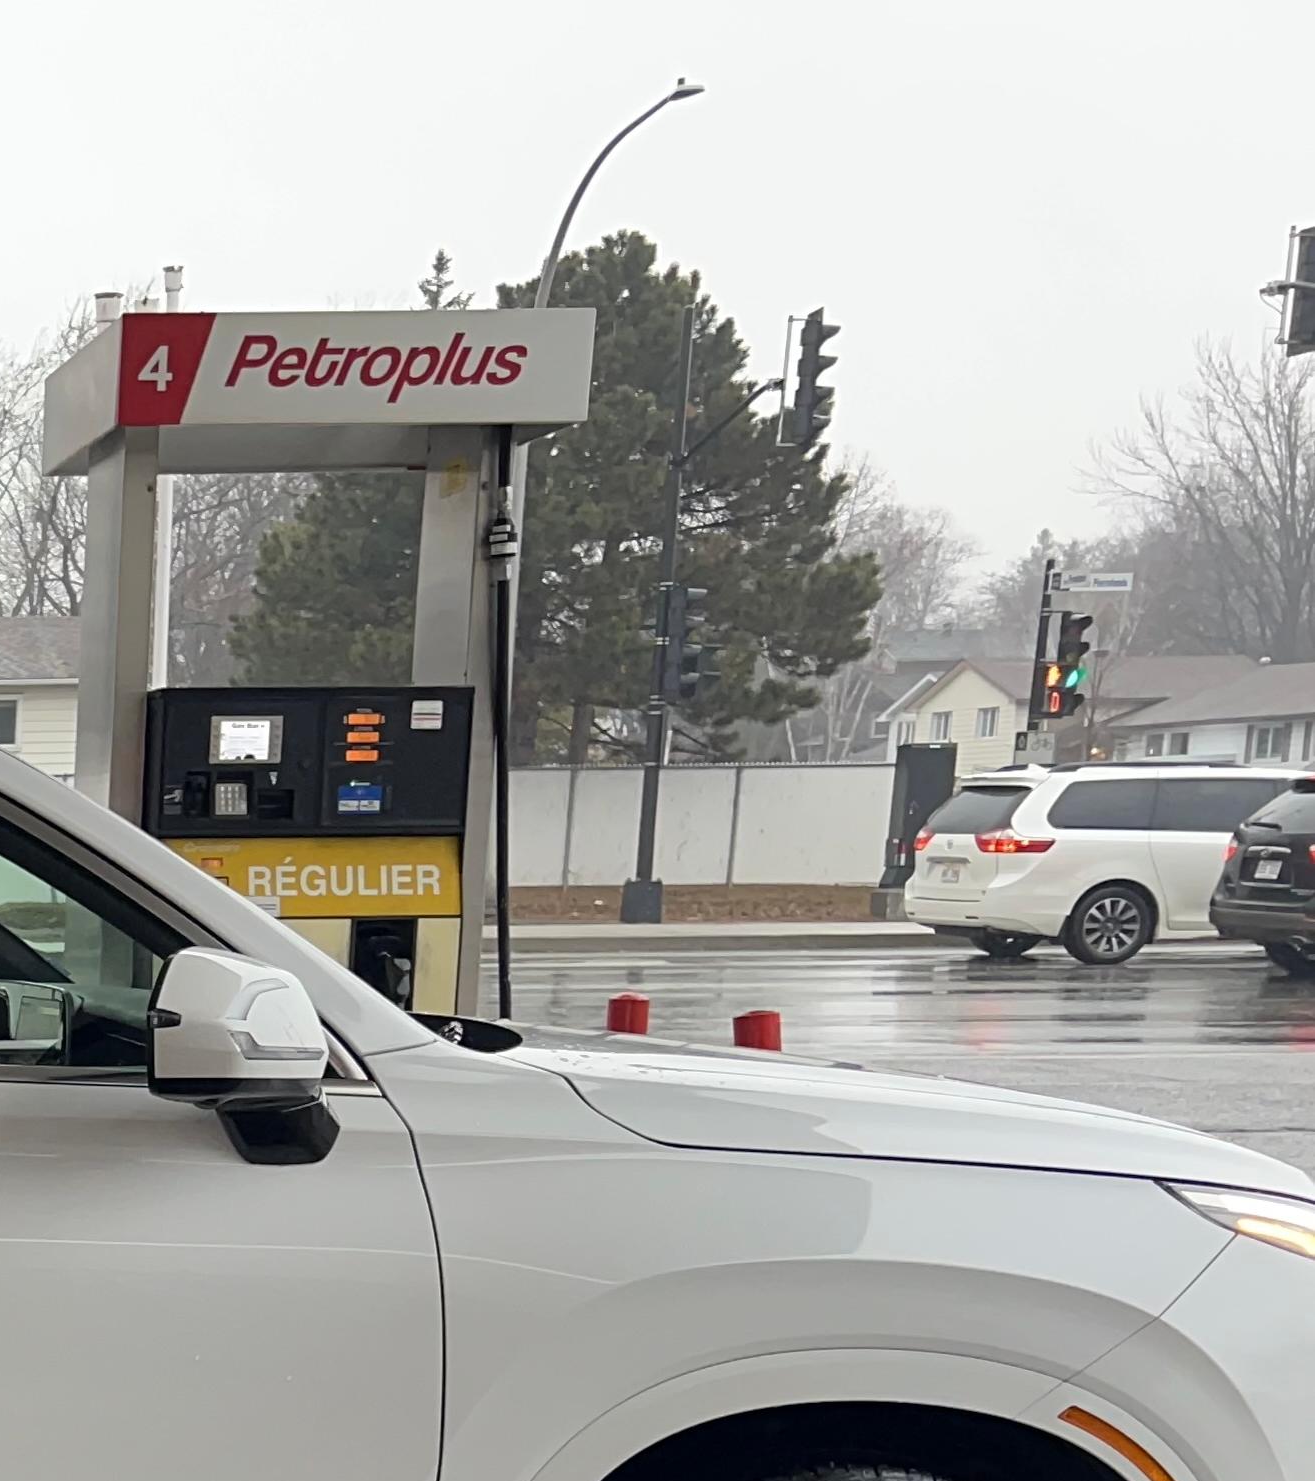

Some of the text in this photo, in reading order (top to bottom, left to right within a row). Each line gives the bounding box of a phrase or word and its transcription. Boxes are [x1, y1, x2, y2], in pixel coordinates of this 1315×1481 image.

[137, 332, 529, 404] 4 Petroplus
[247, 856, 441, 897] RÉGULIER
